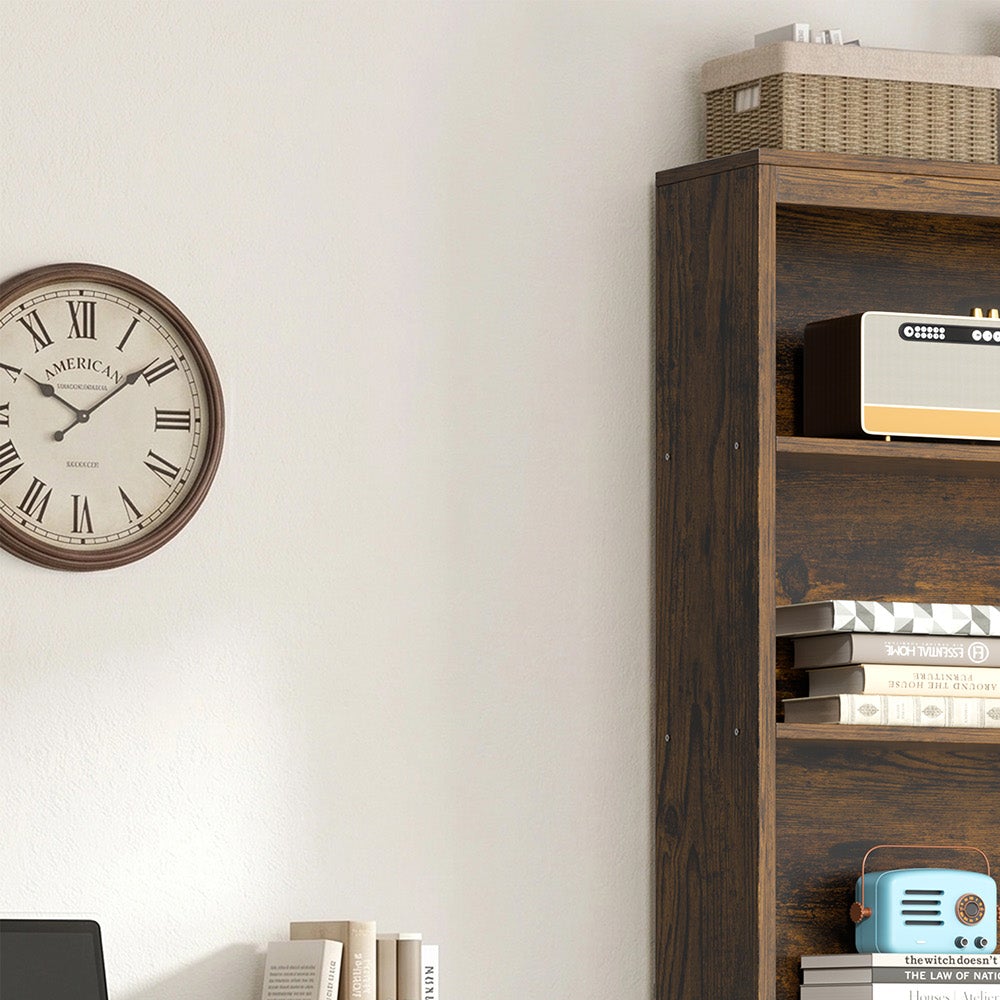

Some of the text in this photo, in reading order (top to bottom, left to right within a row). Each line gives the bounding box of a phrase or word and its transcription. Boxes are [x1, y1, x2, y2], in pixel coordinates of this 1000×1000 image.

[17, 309, 54, 353] XI
[66, 300, 97, 341] XII
[116, 317, 140, 352] I
[45, 357, 125, 385] AMERICAN
[142, 356, 179, 386] II
[154, 408, 191, 432] III
[143, 450, 181, 487] IV
[17, 476, 53, 523] VII
[118, 486, 143, 523] V
[71, 495, 93, 534] VI
[885, 644, 916, 656] HOME
[917, 646, 964, 659] ESSENTIAL
[888, 680, 997, 691] AROUND THE HOUSE
[913, 672, 973, 681] FURNITURE
[905, 955, 923, 965] the
[925, 955, 955, 965] witch
[905, 971, 926, 980] THE
[930, 971, 953, 981] LAW
[956, 972, 970, 981] OF
